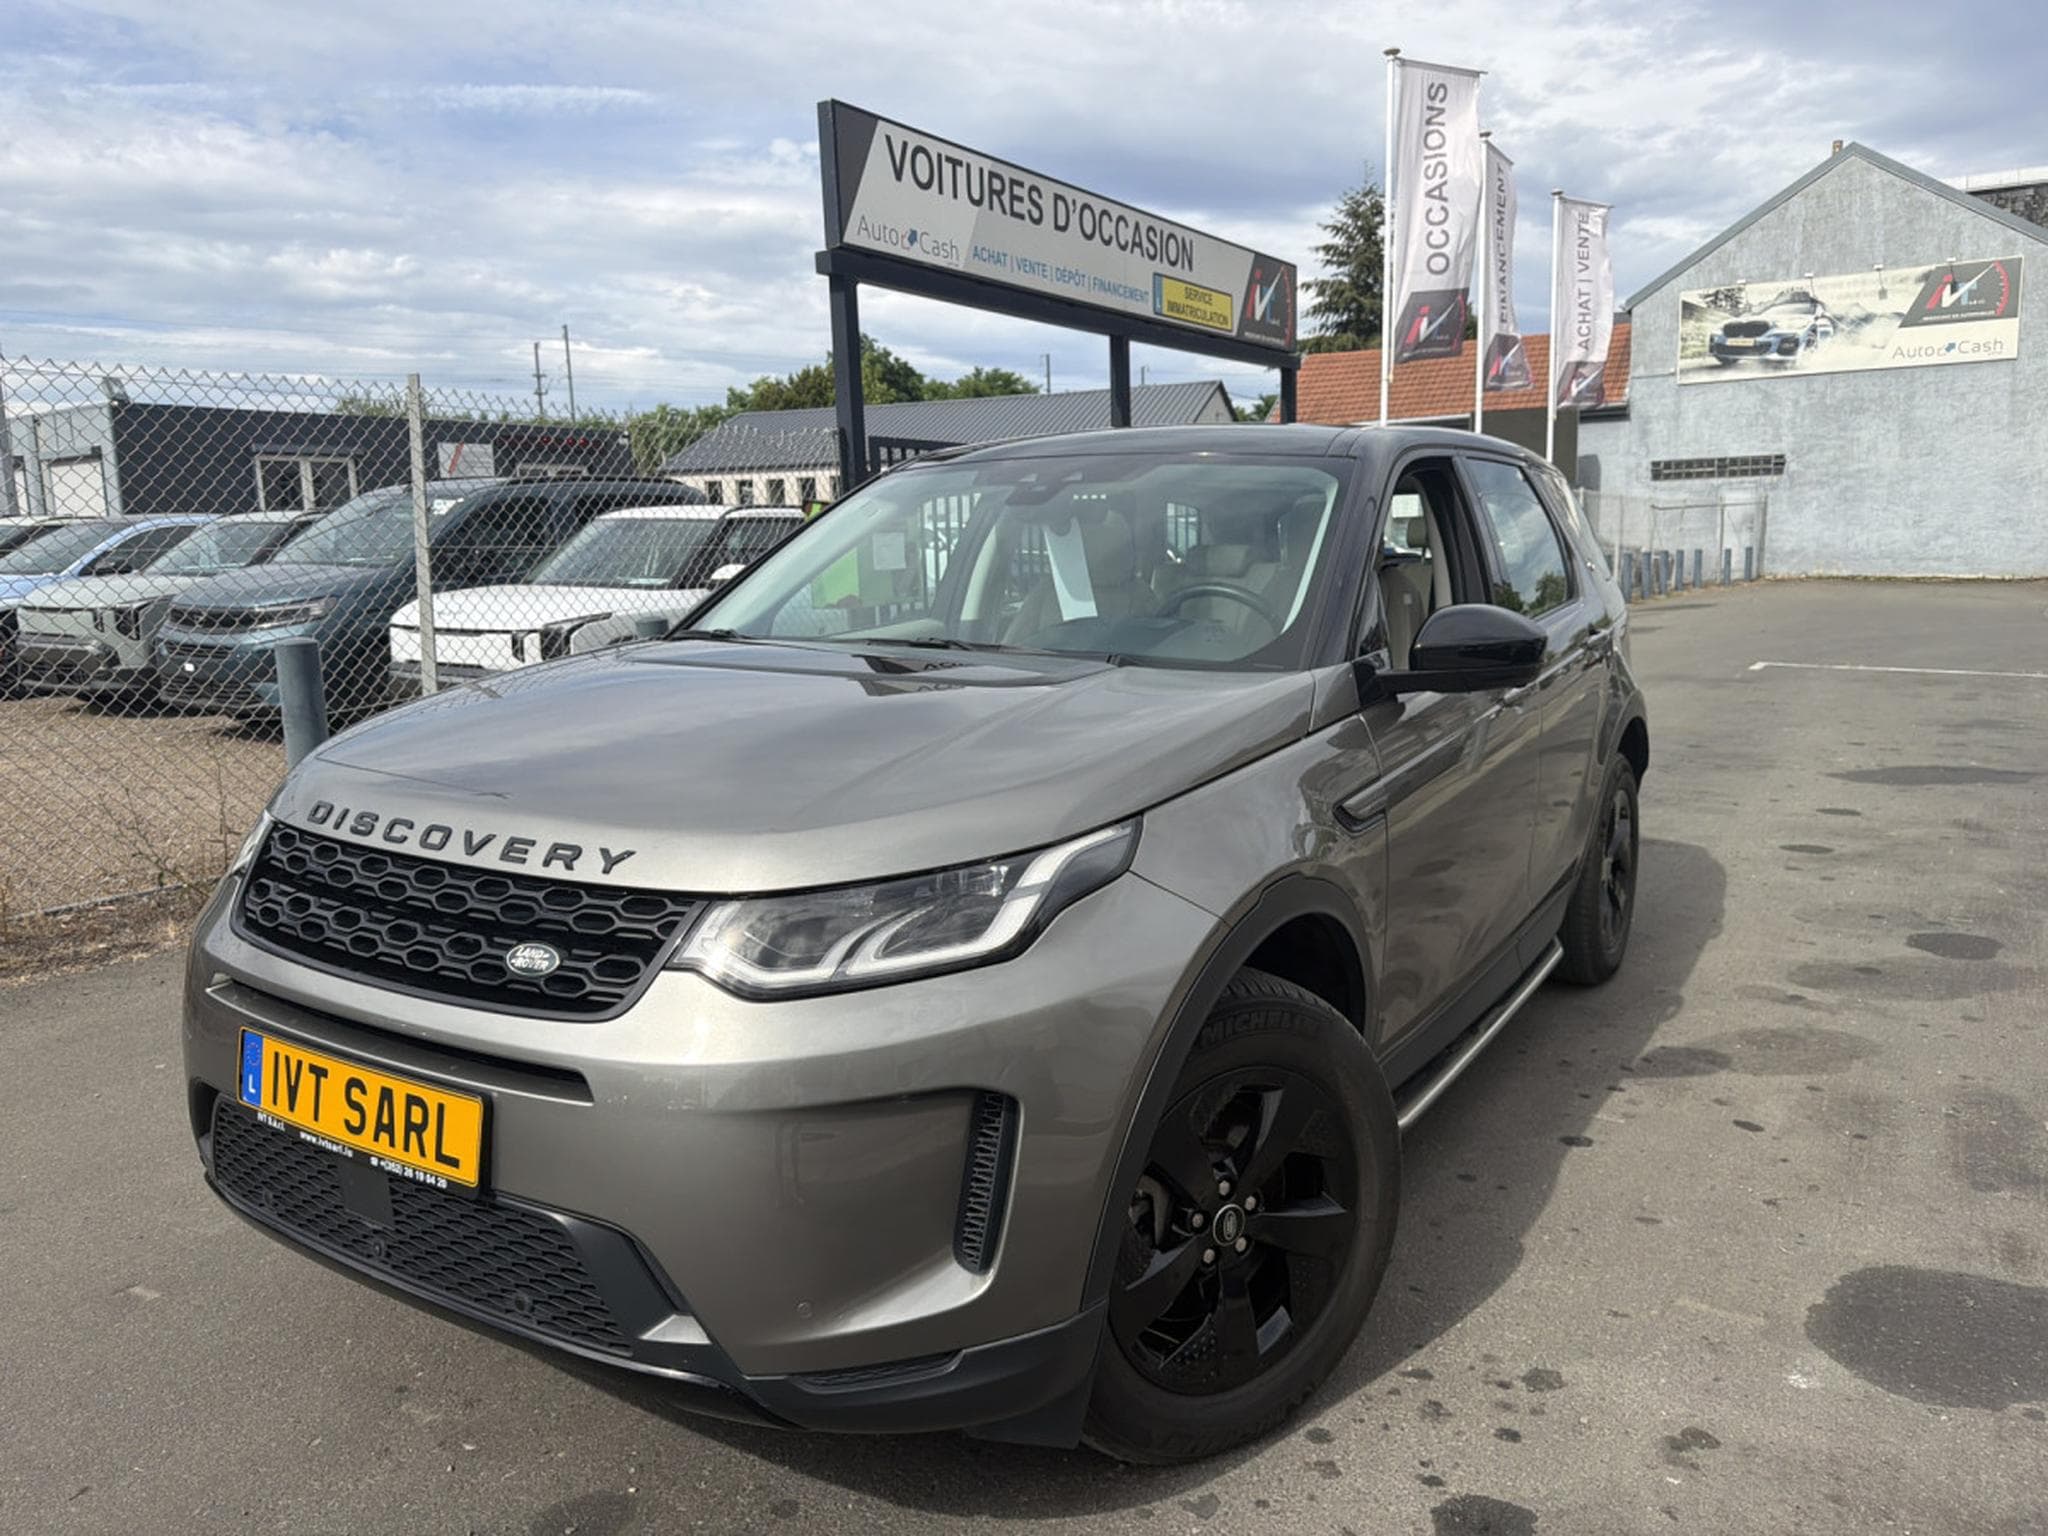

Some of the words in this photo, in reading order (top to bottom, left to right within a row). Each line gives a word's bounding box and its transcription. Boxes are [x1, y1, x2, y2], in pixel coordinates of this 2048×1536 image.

[884, 134, 1044, 226] VOITURES
[1054, 193, 1195, 272] D'OCCASION
[1423, 81, 1451, 276] OCCASIONS
[972, 245, 1008, 267] ACHAT
[1015, 257, 1048, 279] VENTE
[1055, 266, 1087, 288] DÉPÔT
[1092, 276, 1150, 302] FINANCEMENT
[1578, 211, 1591, 273] VENTE
[1166, 300, 1229, 326] IMMATRICULATION
[1184, 286, 1213, 305] SERVICE
[1580, 287, 1592, 352] ACHAT
[306, 800, 638, 875] DISCOVERY
[248, 1074, 256, 1094] L
[272, 1050, 329, 1123] IVT
[343, 1076, 460, 1170] SARL
